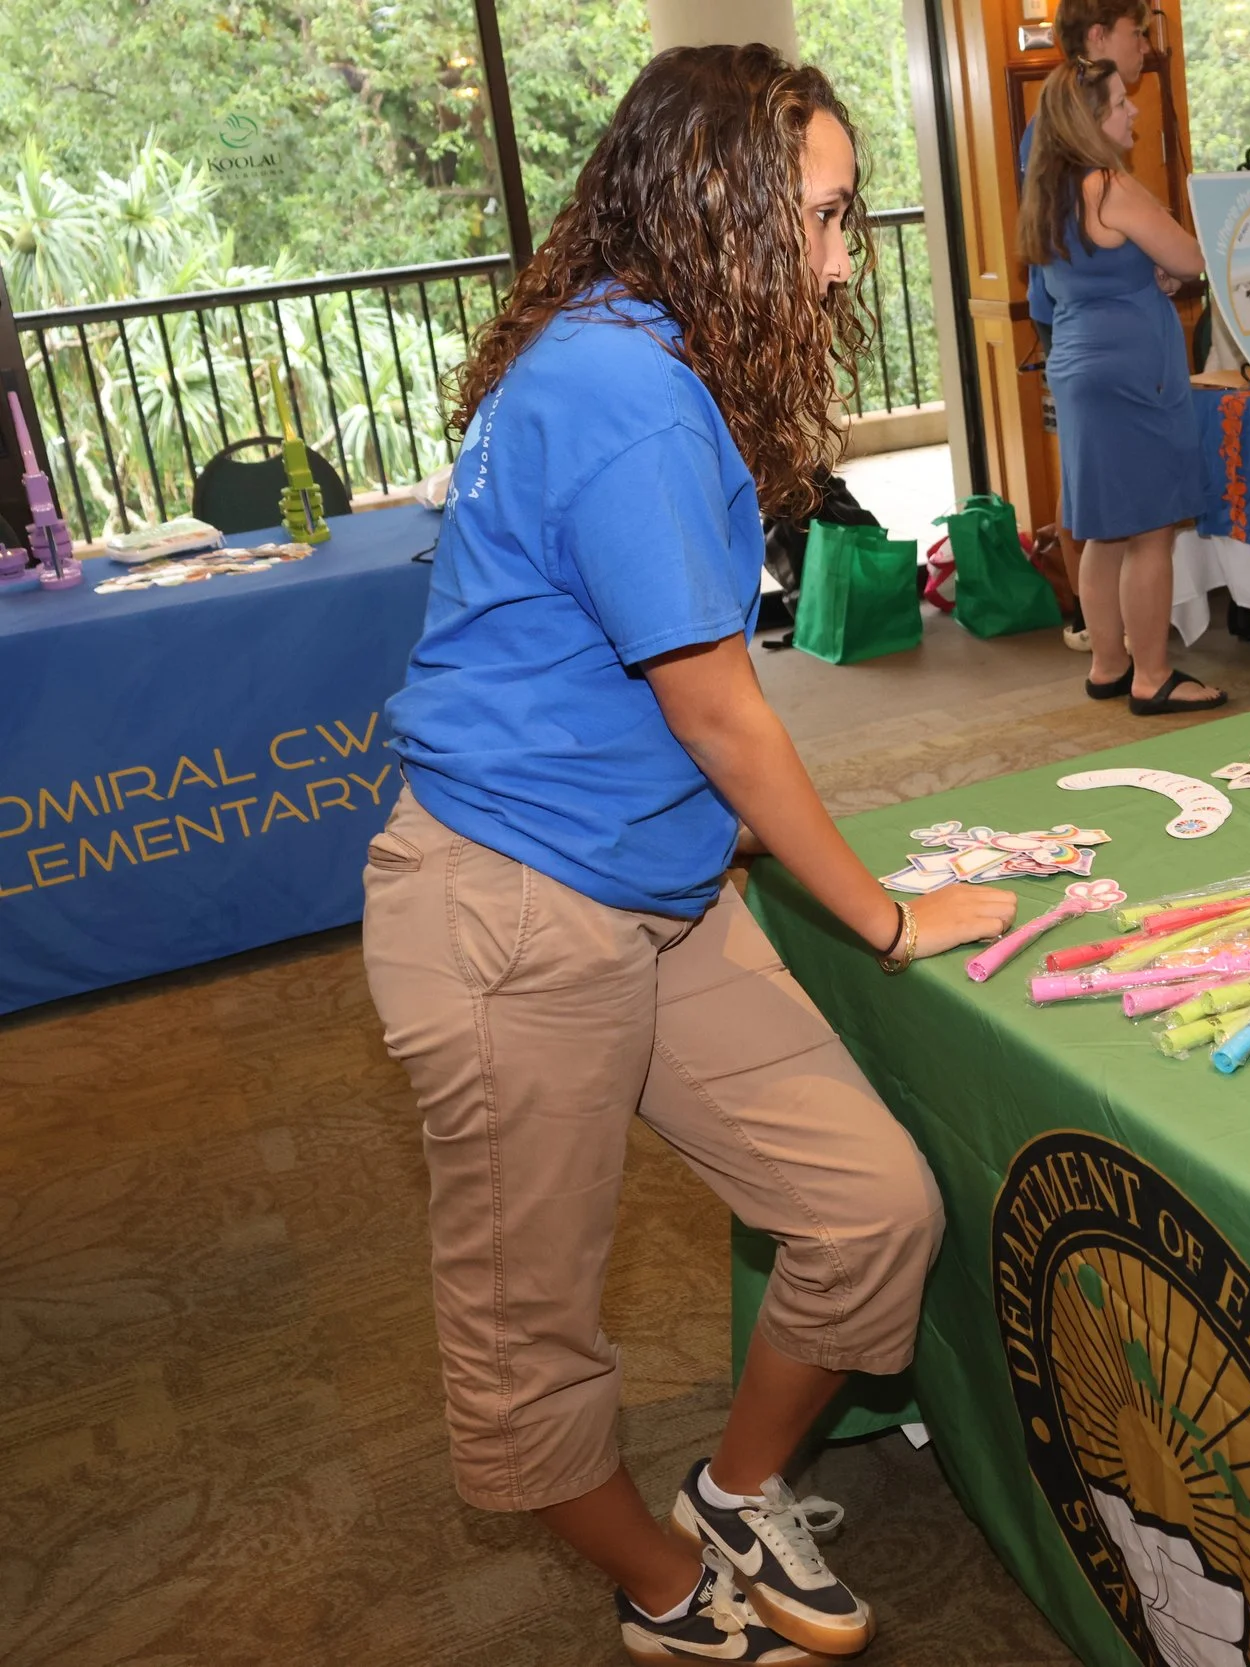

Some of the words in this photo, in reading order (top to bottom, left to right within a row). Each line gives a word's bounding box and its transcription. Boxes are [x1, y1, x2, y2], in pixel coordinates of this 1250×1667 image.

[0, 748, 256, 838] DMIRAL
[0, 764, 392, 897] LEMENTARY
[1000, 1152, 1142, 1388] DEPARTMENT
[1158, 1210, 1204, 1275] OF
